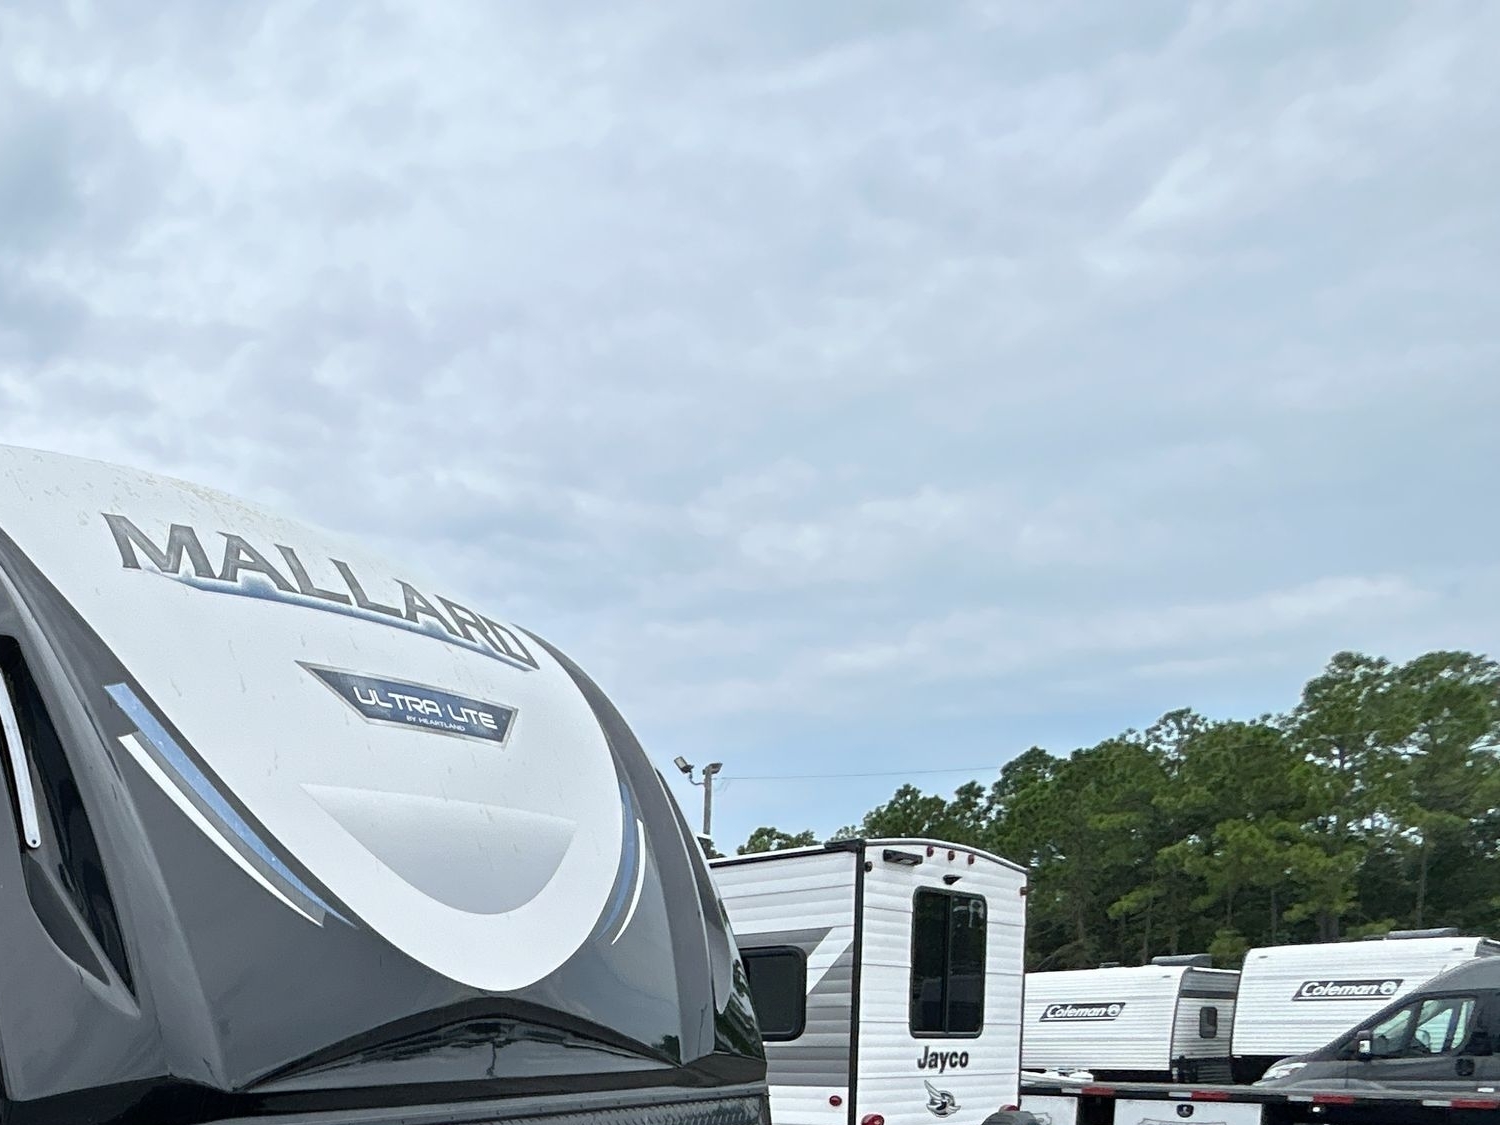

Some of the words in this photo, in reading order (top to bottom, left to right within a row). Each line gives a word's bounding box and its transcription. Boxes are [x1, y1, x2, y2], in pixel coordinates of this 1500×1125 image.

[101, 512, 540, 671] MALLARD
[418, 716, 466, 732] HEARTLAND
[1301, 981, 1380, 997] Coleman
[1046, 1004, 1107, 1018] Coleman
[917, 1045, 969, 1074] Jayco
